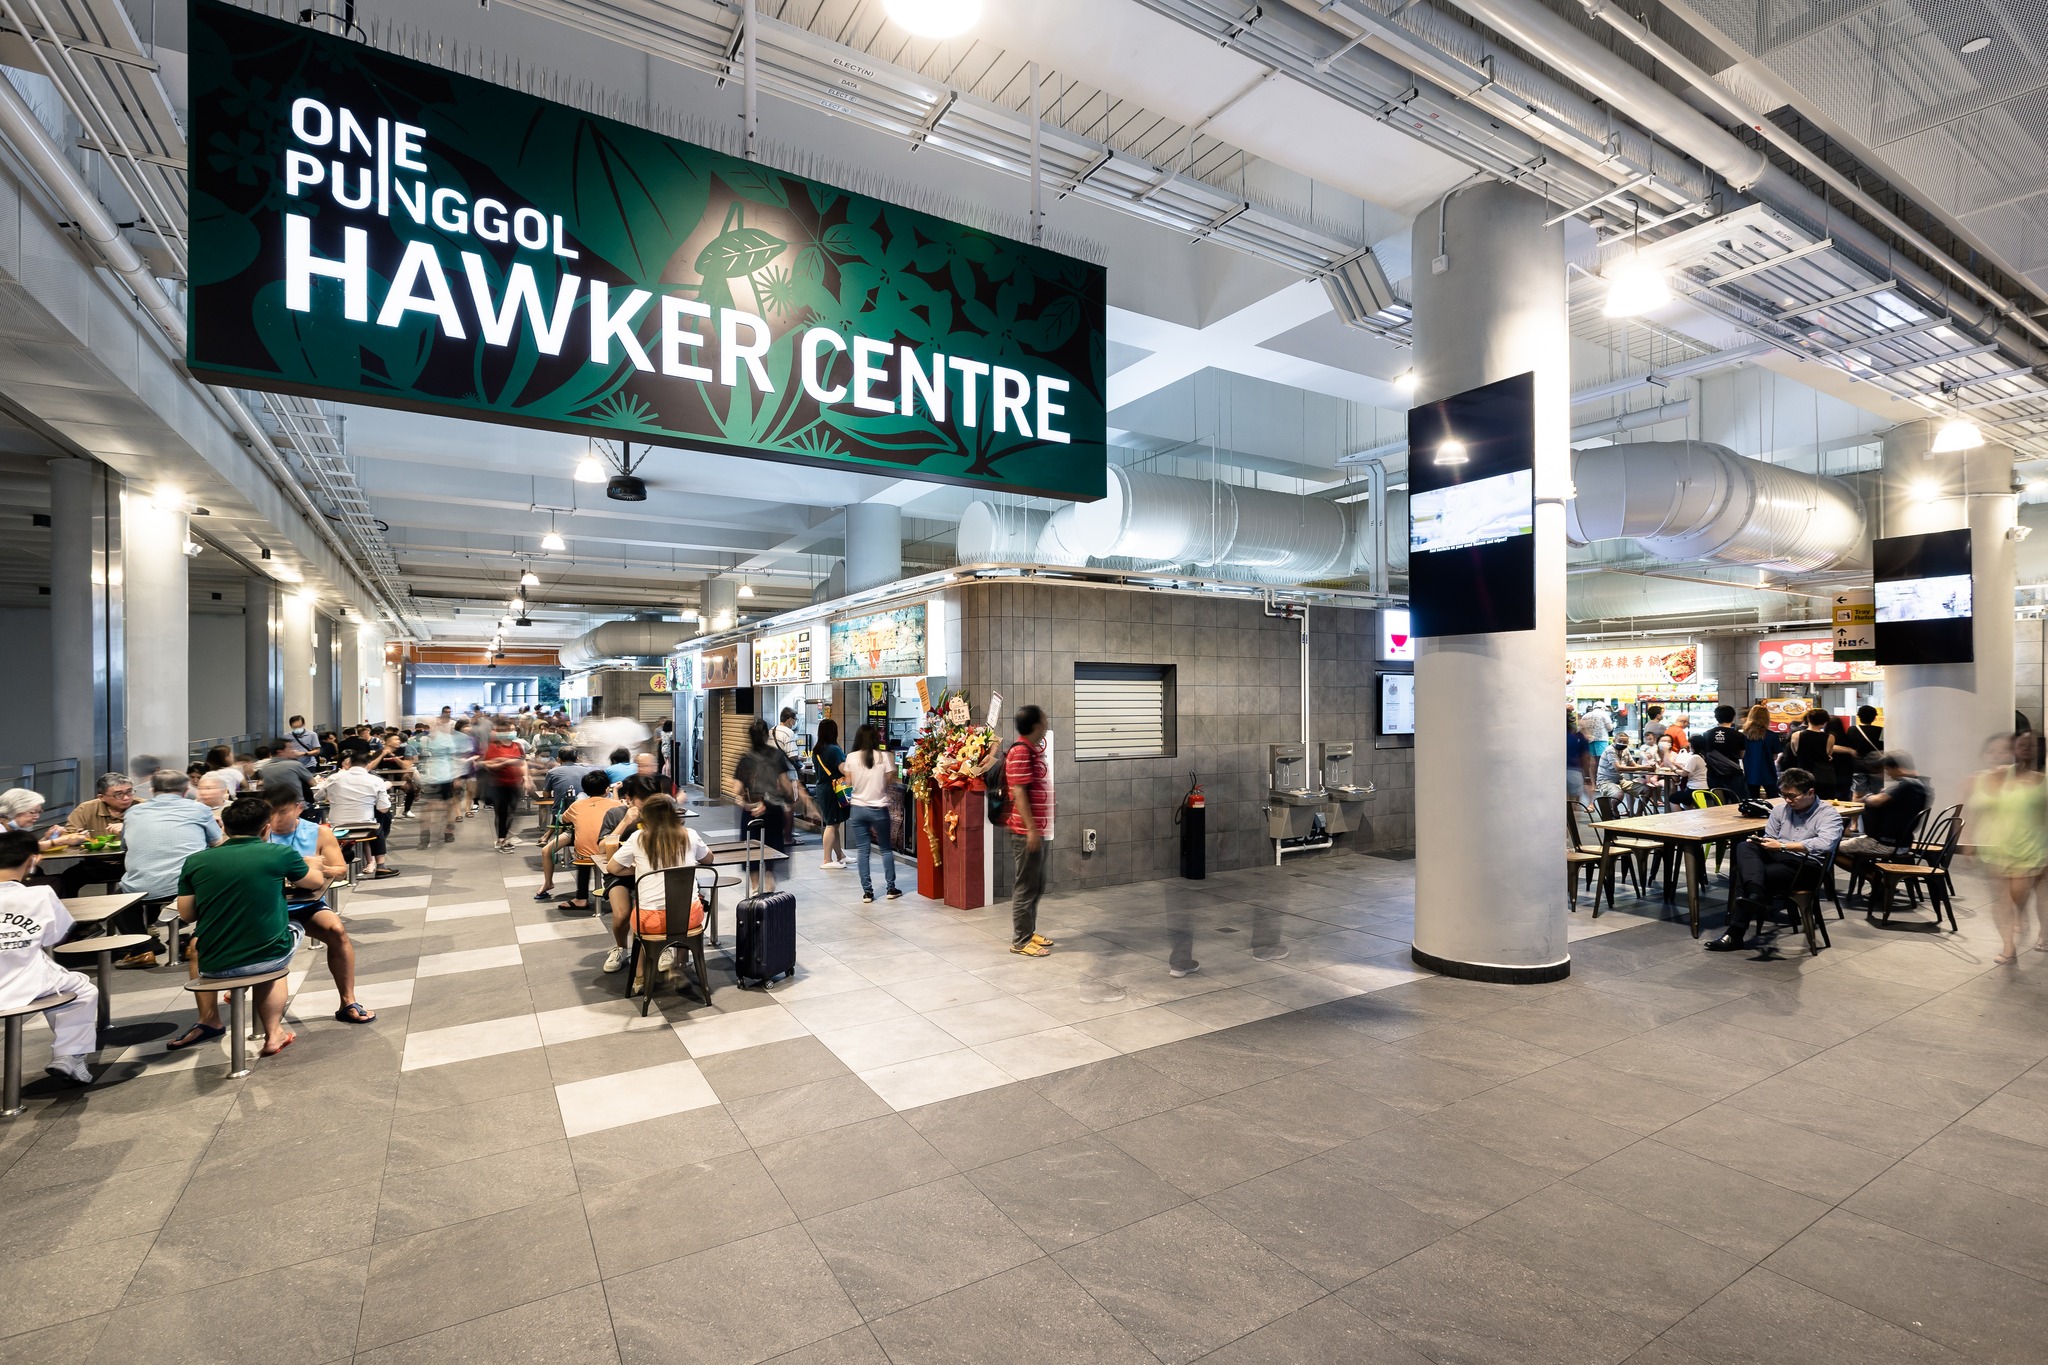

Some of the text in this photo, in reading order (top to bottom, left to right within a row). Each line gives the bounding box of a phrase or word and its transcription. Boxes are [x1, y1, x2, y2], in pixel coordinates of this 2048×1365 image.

[833, 58, 873, 77] ELECT(N)
[829, 89, 848, 99] ELECT
[841, 79, 857, 89] DATA
[820, 100, 840, 110] ELECT
[293, 98, 426, 174] ONE
[287, 150, 578, 259] PUNGGOL
[287, 214, 1070, 443] HAWKER CENTRE
[0, 913, 41, 935] PORE
